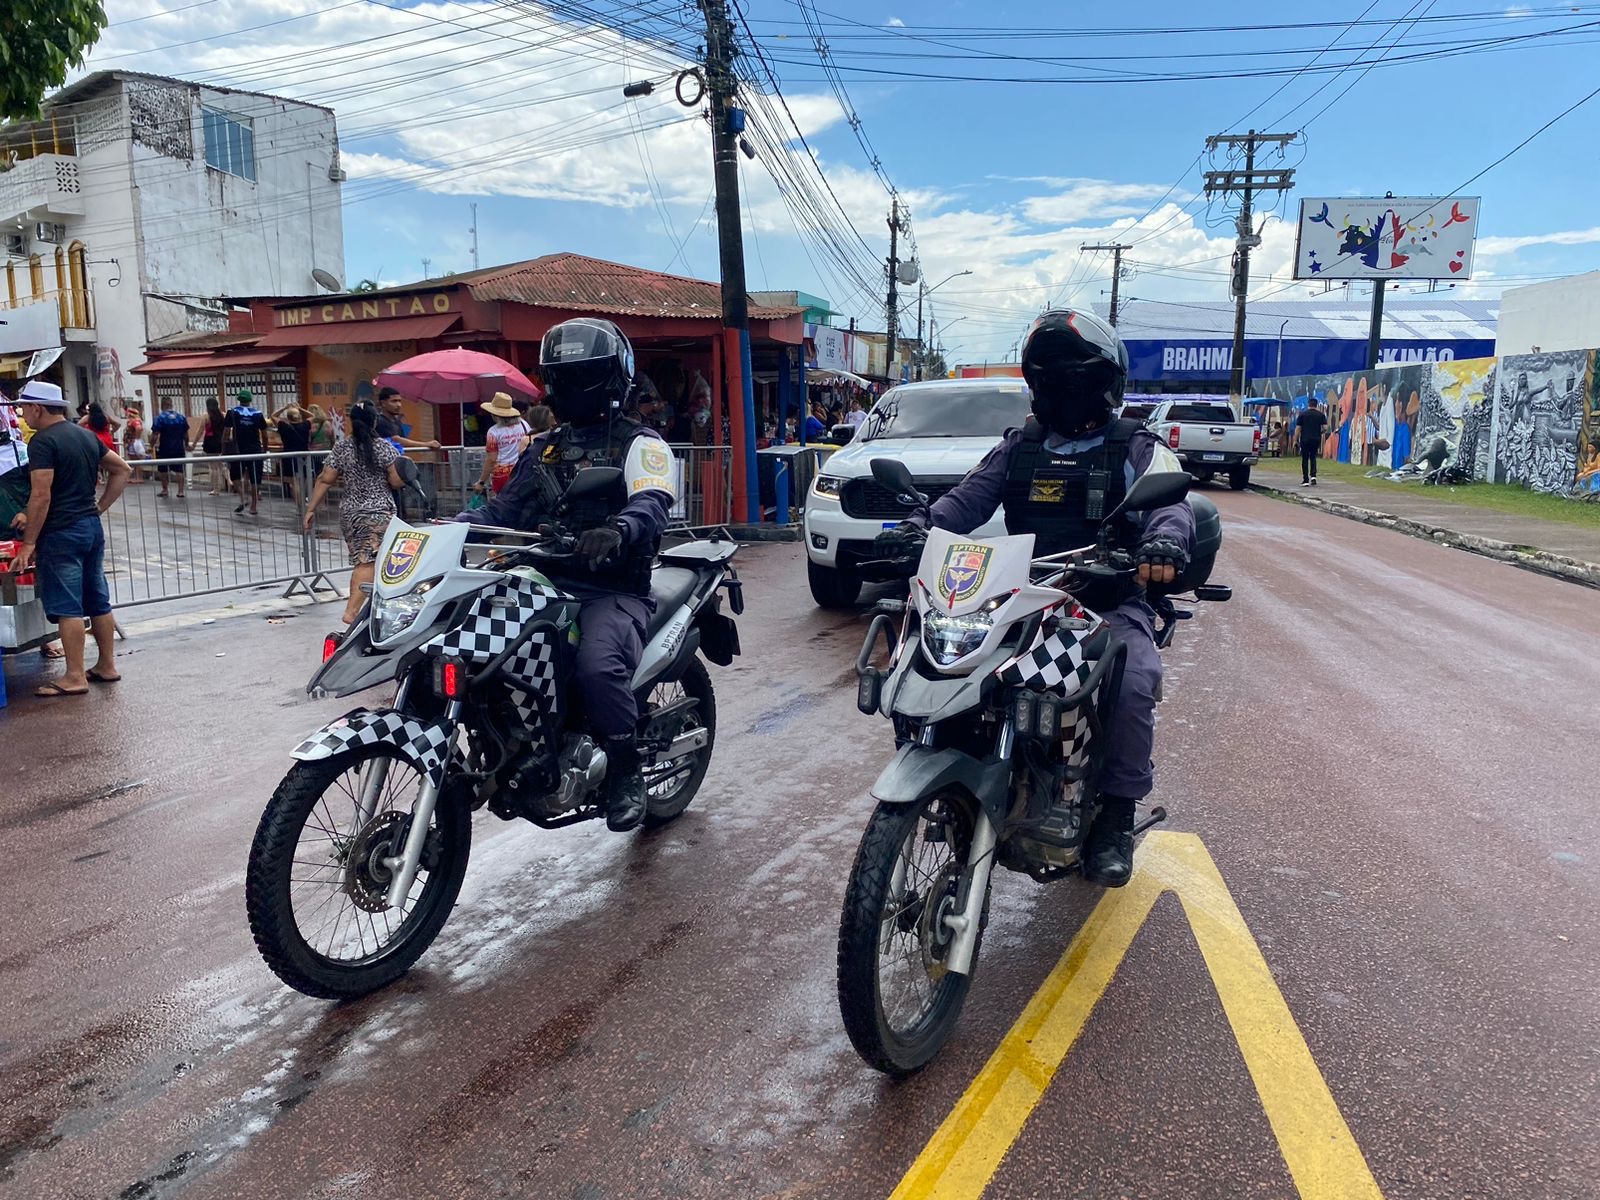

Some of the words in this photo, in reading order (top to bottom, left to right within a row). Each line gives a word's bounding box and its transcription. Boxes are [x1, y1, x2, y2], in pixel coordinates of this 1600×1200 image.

[281, 308, 311, 326] IMP
[399, 532, 425, 540] BPTRAN
[953, 544, 988, 554] BPTRAN
[660, 621, 684, 650] BPTRAN
